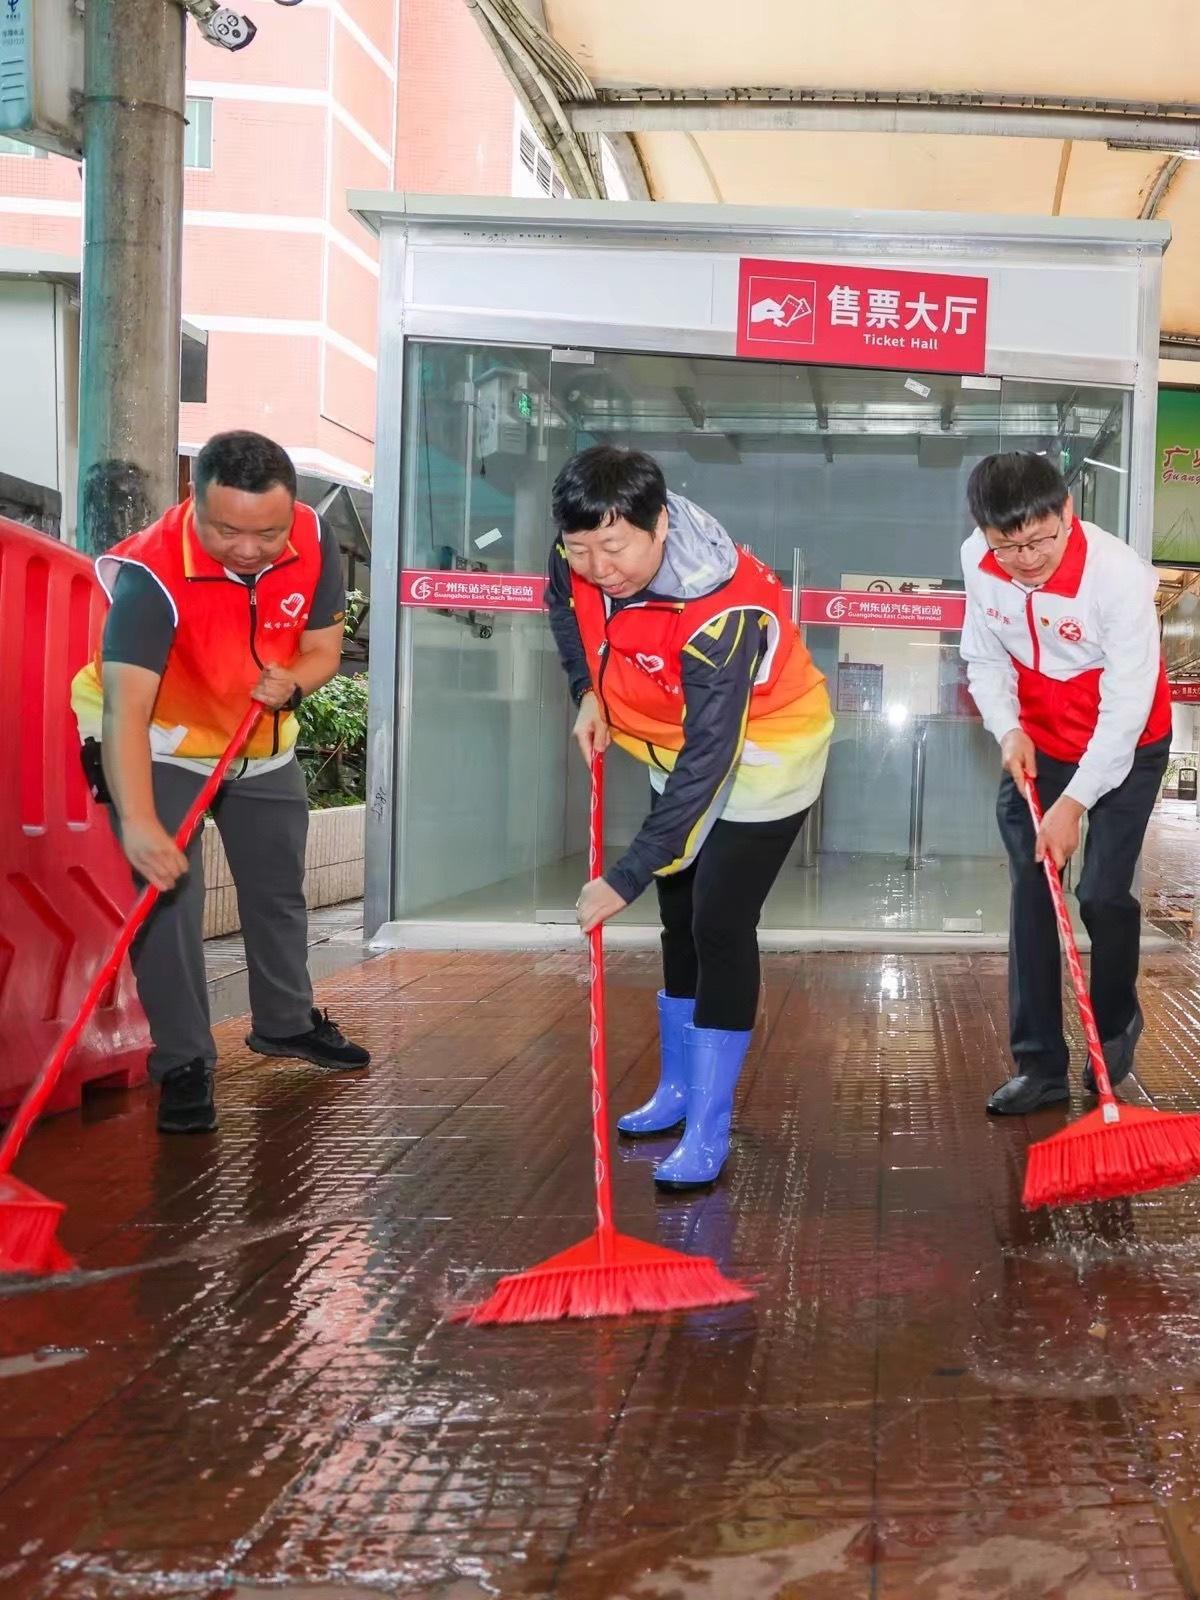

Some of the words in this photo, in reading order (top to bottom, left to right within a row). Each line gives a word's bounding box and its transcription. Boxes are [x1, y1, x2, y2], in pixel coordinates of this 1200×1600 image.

[827, 285, 978, 335] 售票大厅
[863, 334, 905, 348] Ticket
[911, 337, 938, 350] Hall
[434, 582, 533, 596] 广州东站汽车客运站
[434, 591, 470, 600] Guangzhou
[848, 601, 942, 615] 广州东站汽车客运站
[848, 611, 881, 620] Guangzhou
